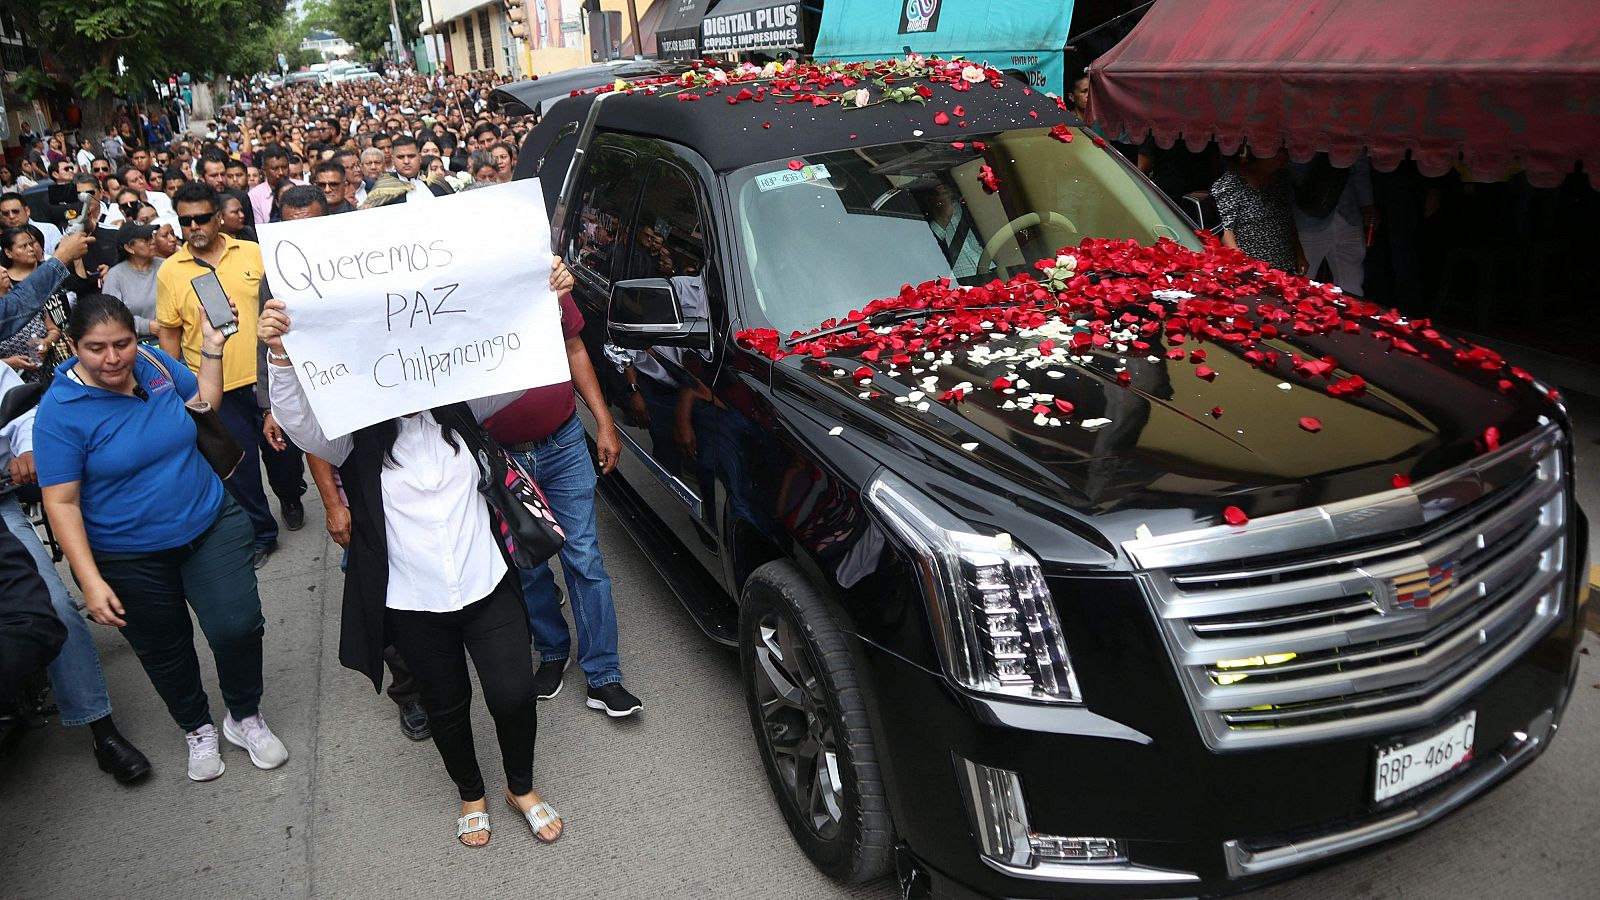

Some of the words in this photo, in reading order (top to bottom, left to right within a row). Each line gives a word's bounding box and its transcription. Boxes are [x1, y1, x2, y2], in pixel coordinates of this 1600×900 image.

[703, 12, 754, 36] DIGITAL
[756, 4, 798, 30] PLUS
[704, 36, 731, 47] COPIAS
[732, 36, 738, 45] E
[738, 28, 798, 45] IMPRESIONES
[1011, 56, 1027, 65] VENTA
[1028, 56, 1039, 65] POR
[274, 239, 453, 299] Queremos
[386, 283, 467, 332] PAZ
[302, 360, 350, 390] Para
[373, 332, 521, 389] Chilpancingo
[1378, 723, 1474, 790] RBP-466-C
